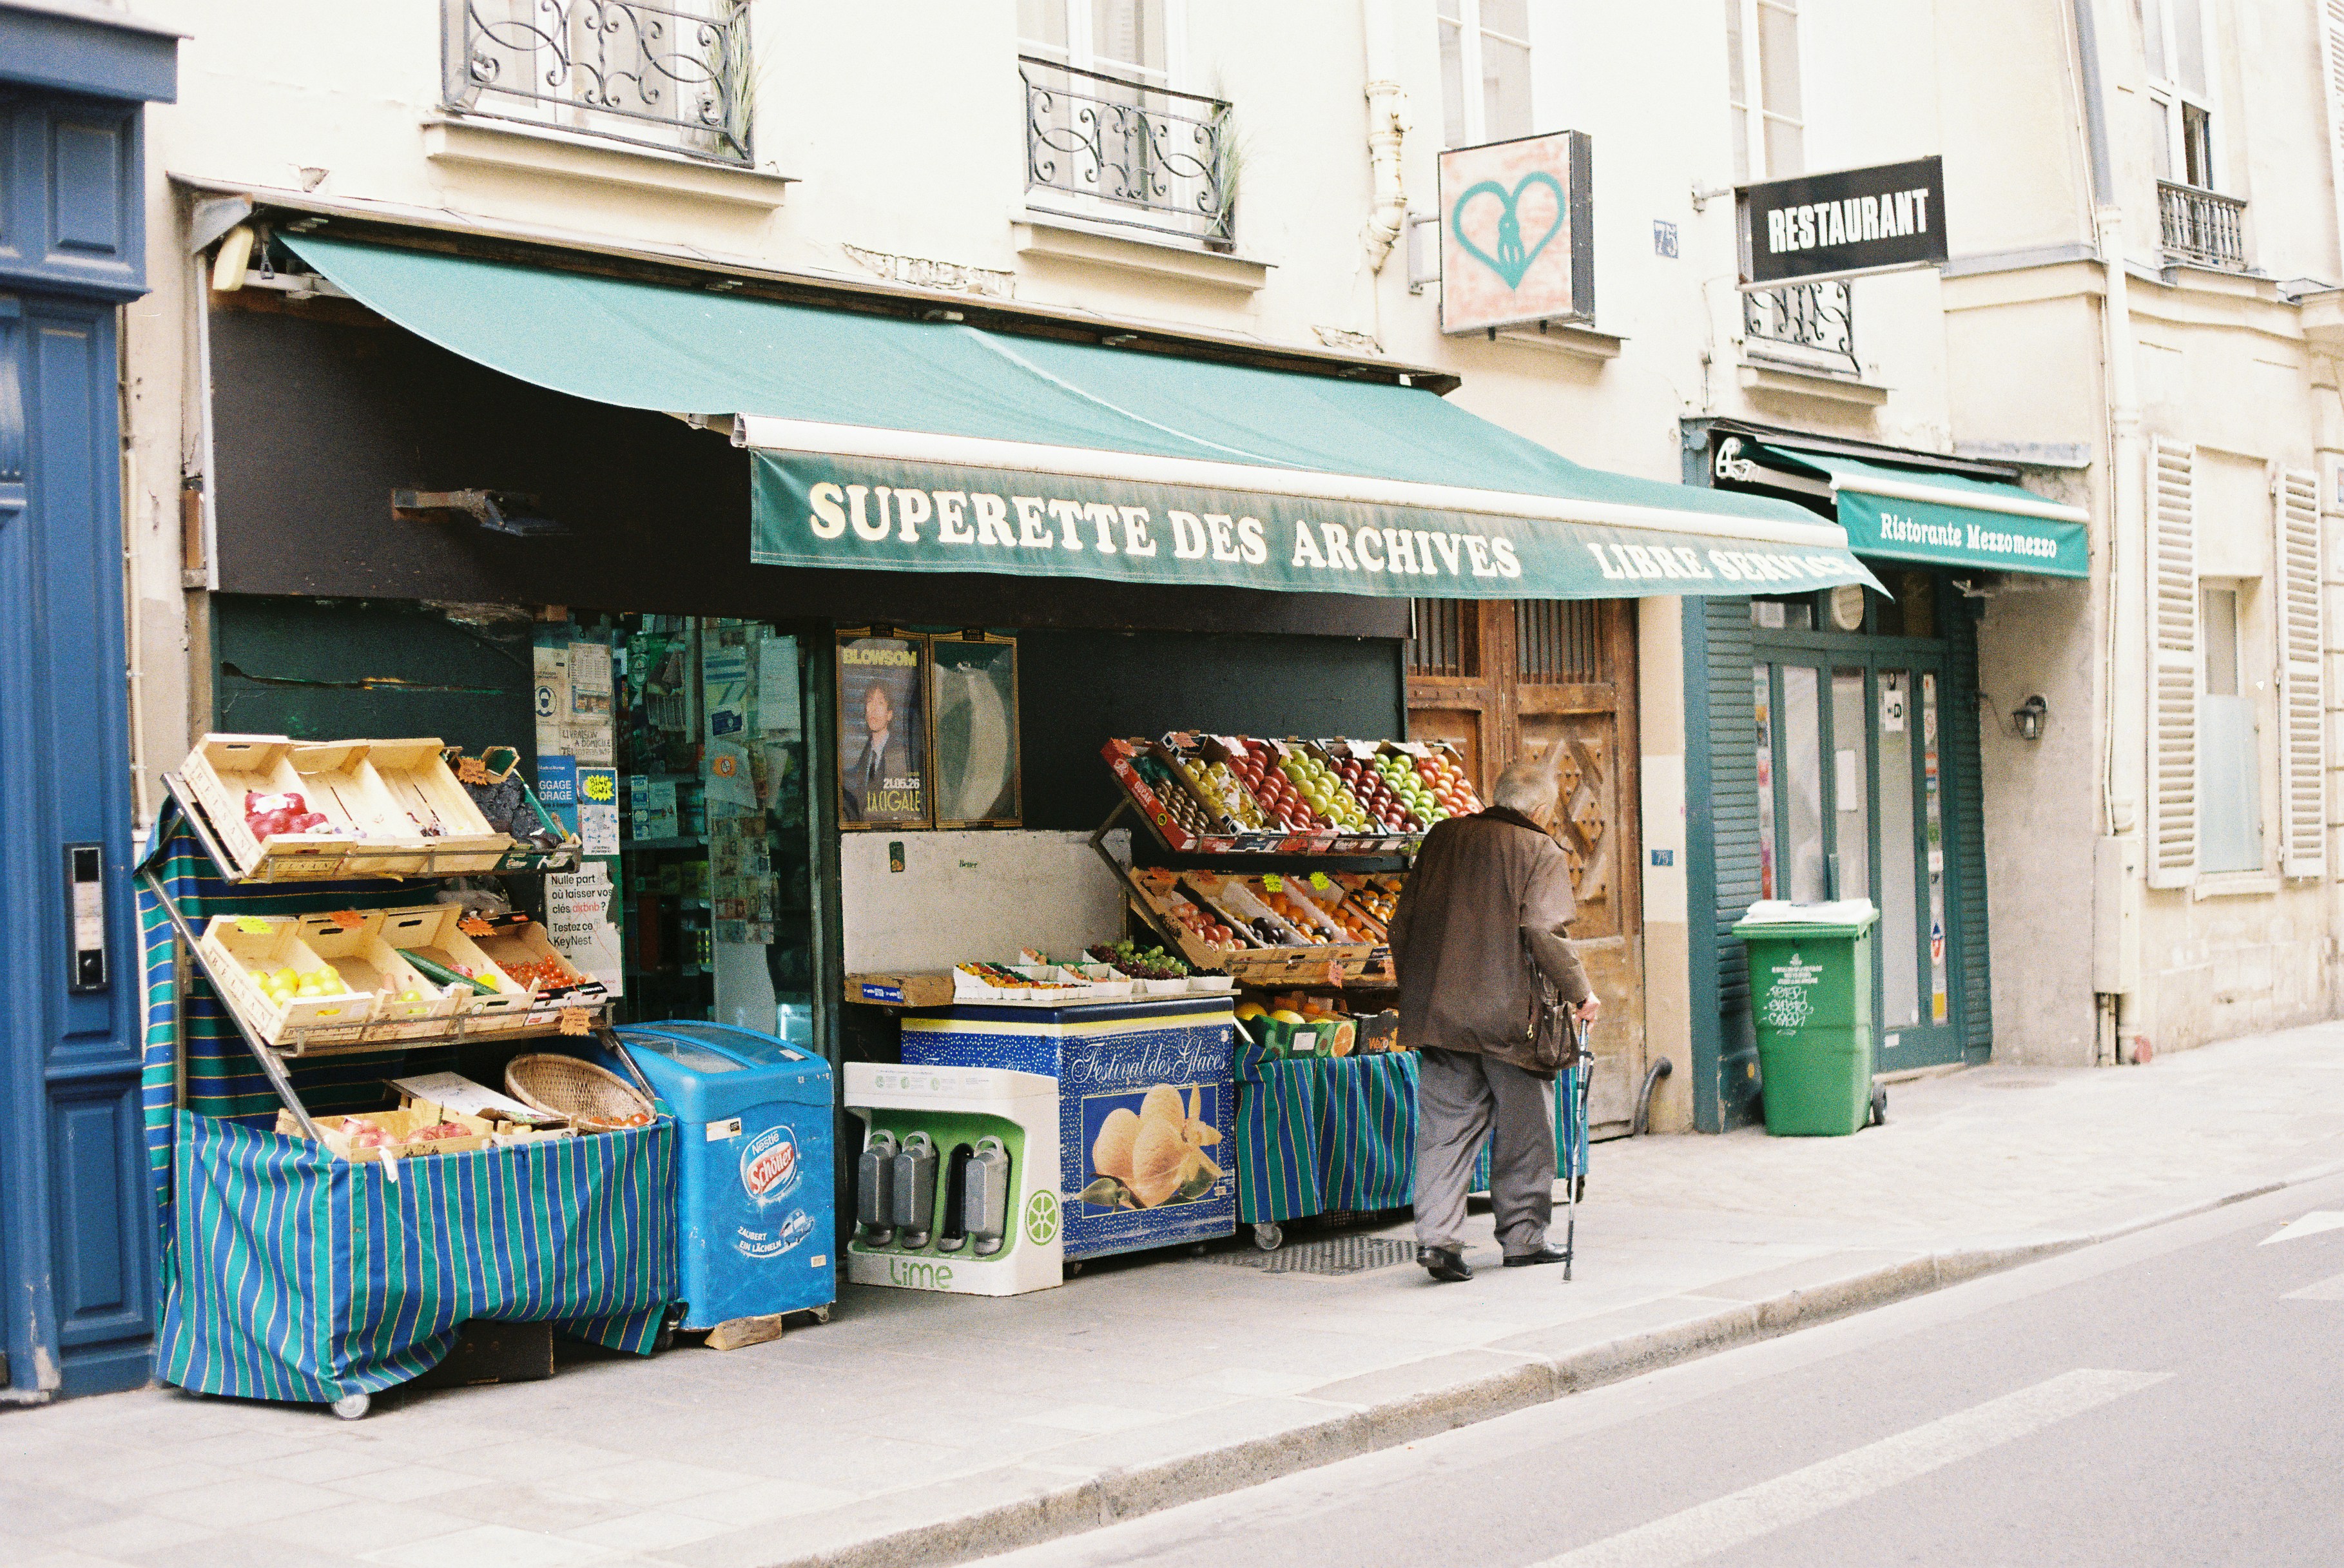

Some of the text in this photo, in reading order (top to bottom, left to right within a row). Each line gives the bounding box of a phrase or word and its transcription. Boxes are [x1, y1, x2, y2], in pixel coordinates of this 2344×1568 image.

[1768, 189, 1928, 254] RESTAURANT
[1655, 224, 1677, 256] 75
[809, 481, 1522, 578] SUPERETTE DES ARCHIVES
[1880, 512, 2058, 559] Ristorante Mezzomezzo
[1587, 542, 1865, 581] LIBRE SERVICE
[843, 648, 917, 667] BLOWSOM
[883, 778, 920, 789] 21.05.26
[1133, 780, 1153, 806] OSCAR
[867, 789, 921, 812] LA CIGALE
[551, 874, 596, 887] Nulle part
[552, 888, 612, 900] où laisser vos
[552, 901, 606, 914] clés airbnb ?
[553, 922, 581, 932] Testez
[553, 935, 592, 949] KeyNest
[1071, 1031, 1226, 1083] Festival des Glaces
[751, 1130, 780, 1156] Nestlé
[750, 1145, 792, 1195] Schöller
[737, 1226, 768, 1241] ZAUBERT
[739, 1239, 782, 1253] EIN LÄCHELN
